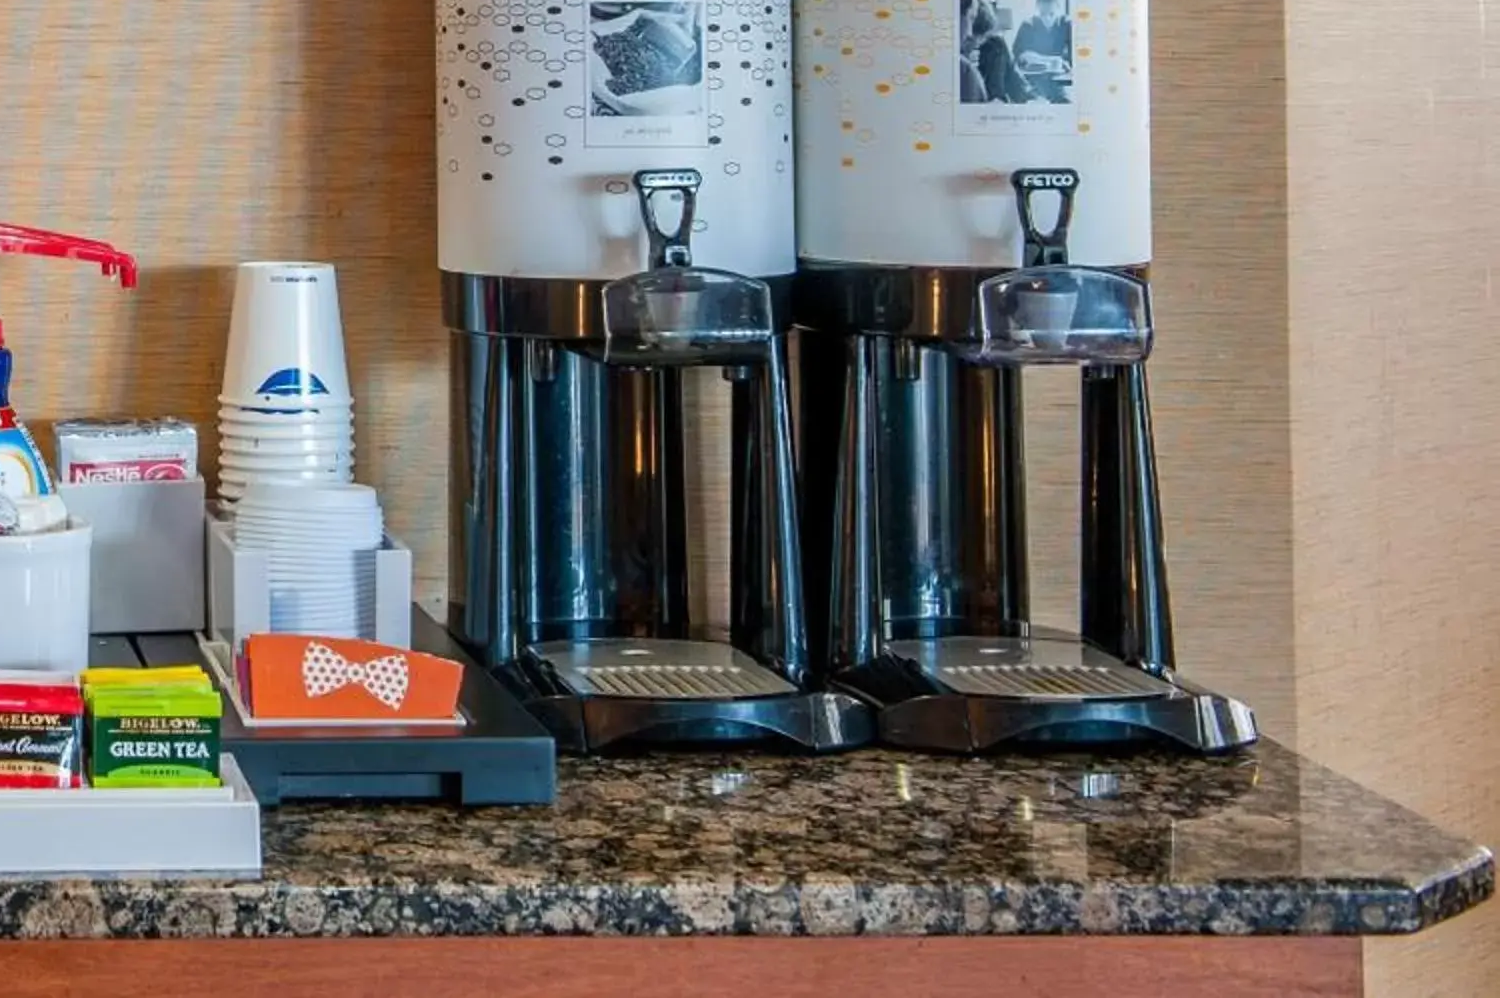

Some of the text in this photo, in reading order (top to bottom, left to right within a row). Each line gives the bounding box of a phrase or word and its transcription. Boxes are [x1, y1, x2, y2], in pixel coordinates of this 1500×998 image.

[1023, 173, 1074, 187] FETCO
[120, 717, 201, 729] BIGELOW
[109, 741, 211, 758] GREEN TEA
